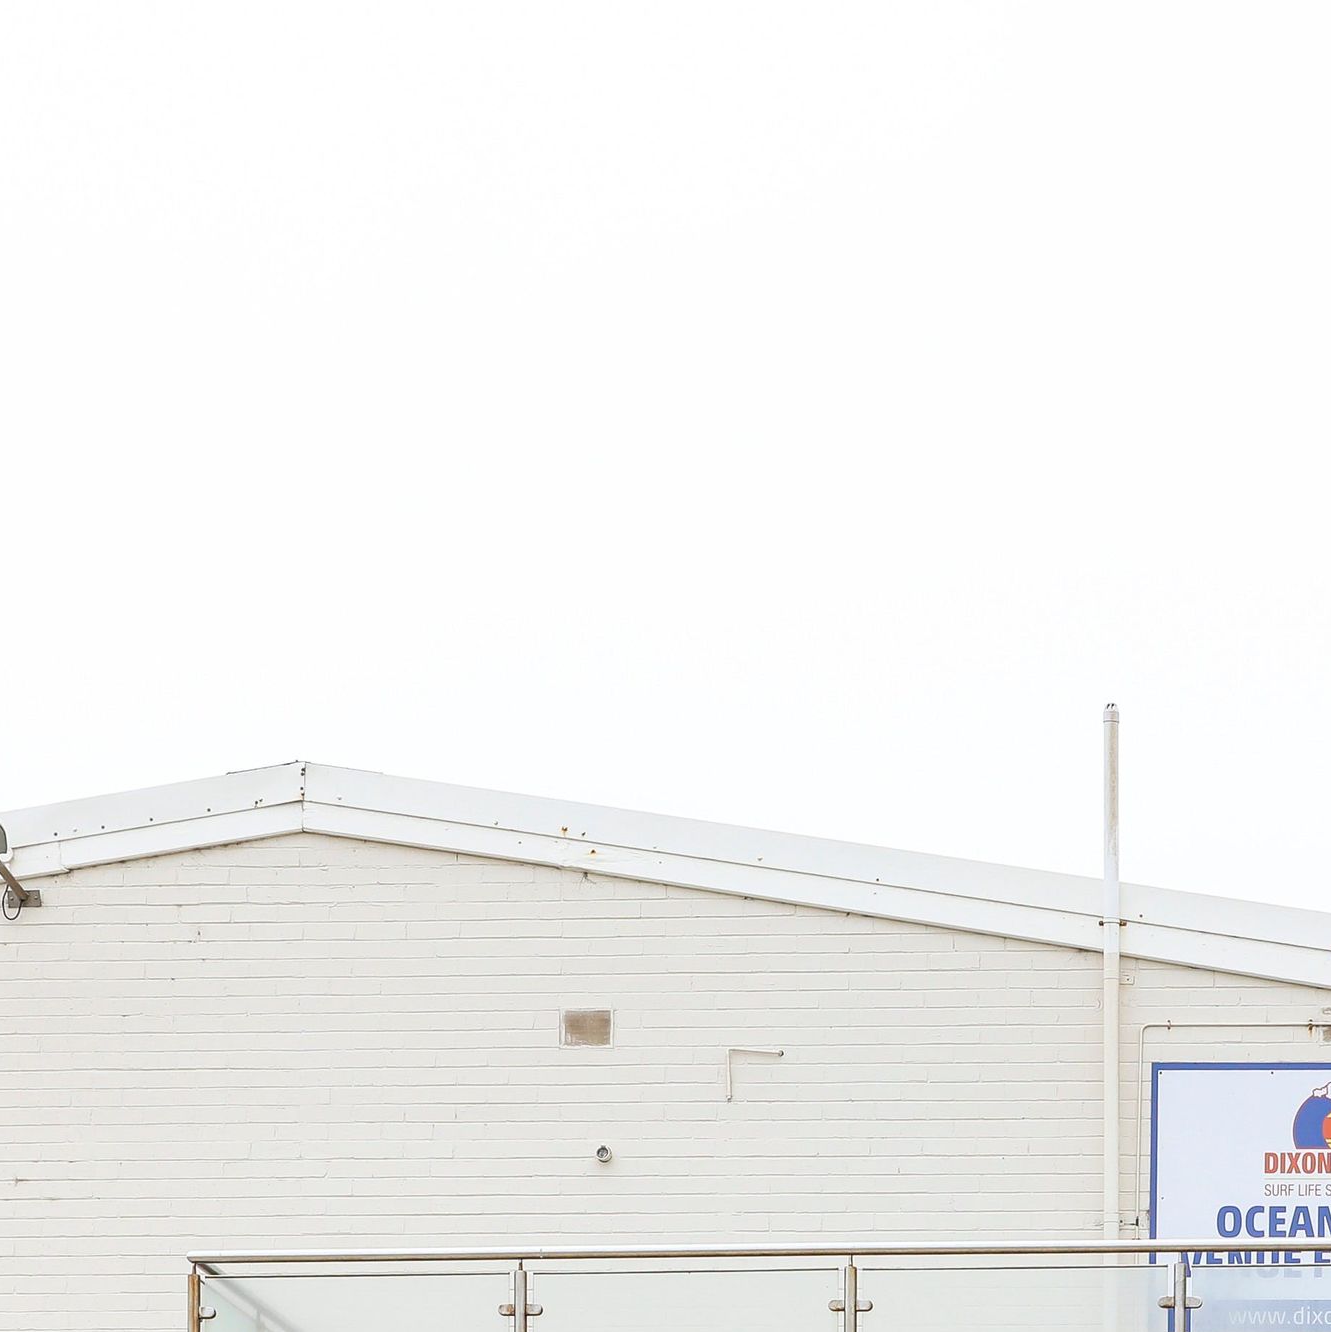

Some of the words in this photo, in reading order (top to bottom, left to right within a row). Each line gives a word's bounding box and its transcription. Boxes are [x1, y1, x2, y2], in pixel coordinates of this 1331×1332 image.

[1264, 1152, 1331, 1174] DIXON
[1264, 1184, 1294, 1196] SURF
[1298, 1184, 1322, 1196] LIFE
